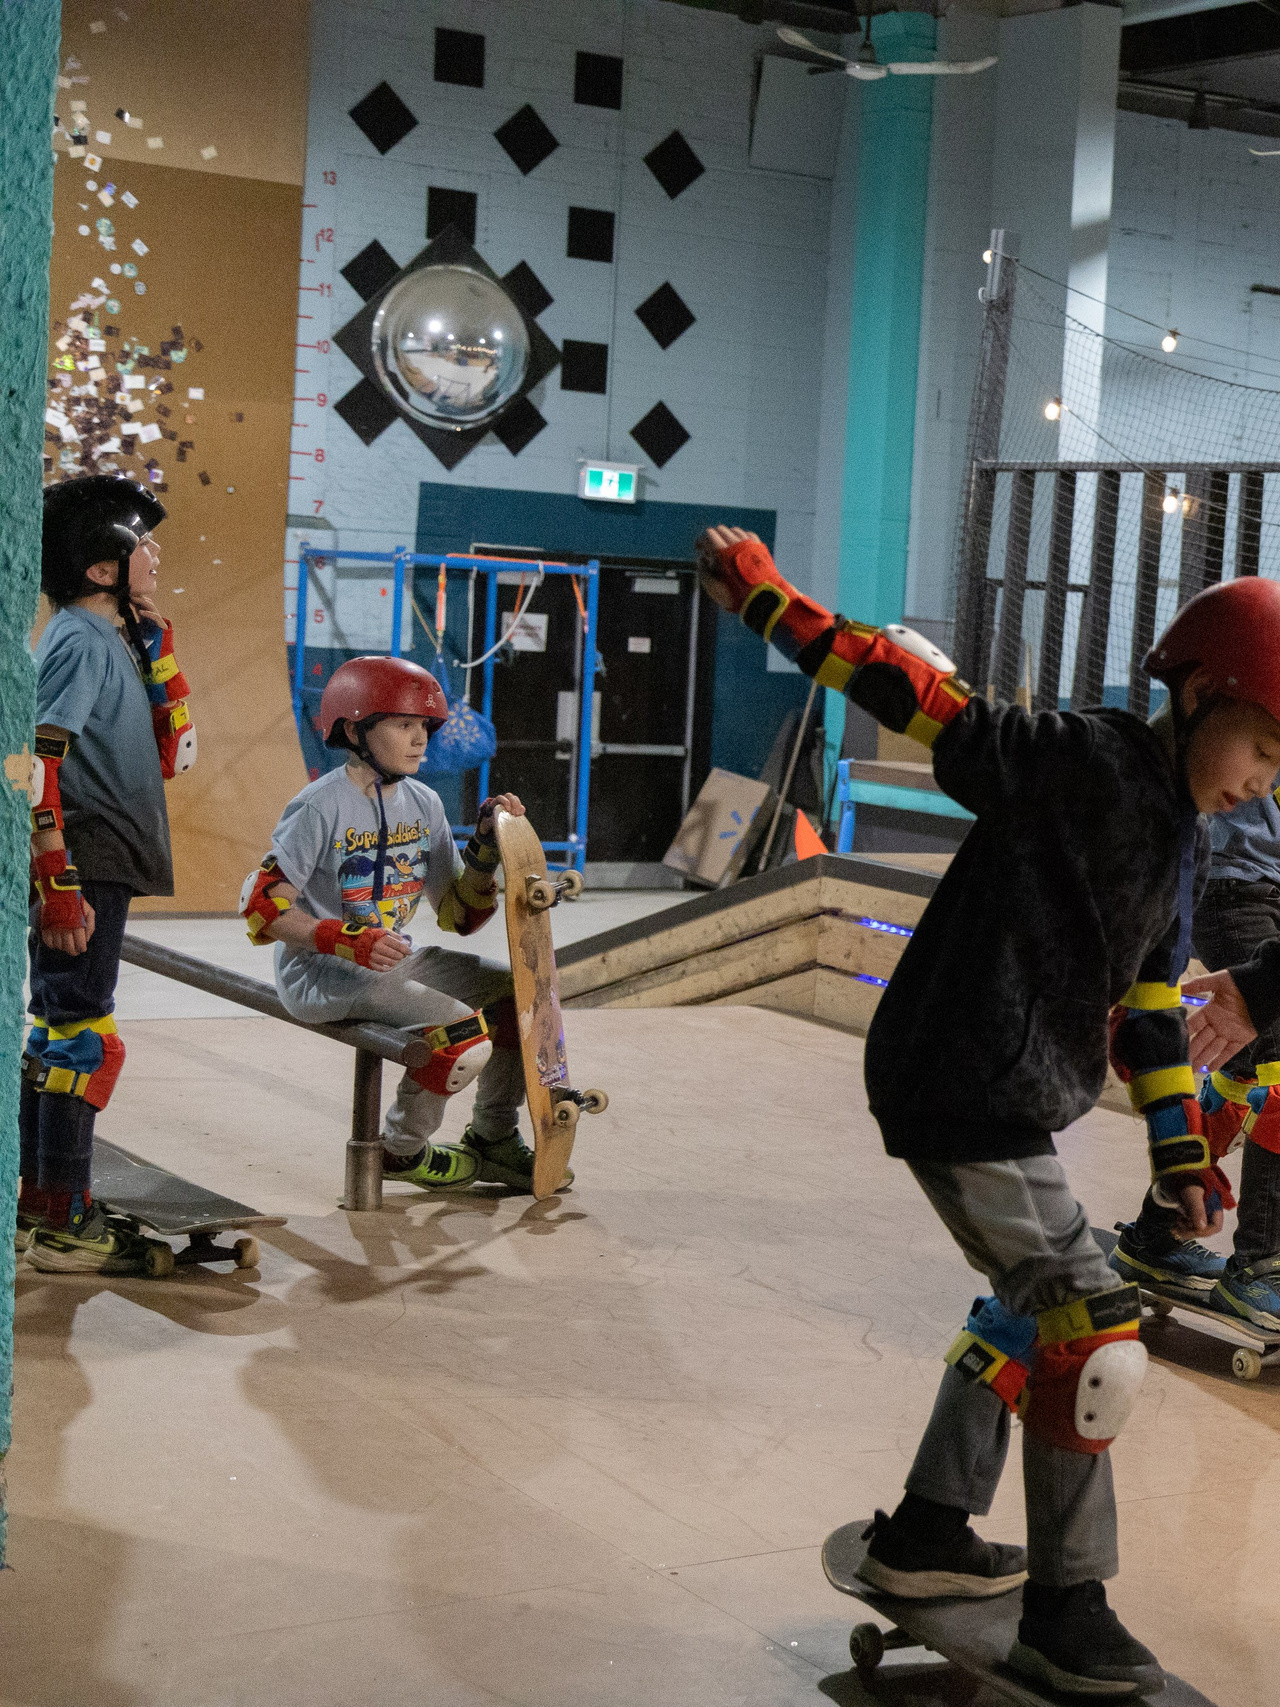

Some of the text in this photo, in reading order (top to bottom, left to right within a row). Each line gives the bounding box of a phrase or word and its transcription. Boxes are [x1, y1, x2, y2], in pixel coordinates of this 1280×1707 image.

[322, 170, 337, 185] 13
[319, 227, 334, 243] 12
[319, 283, 332, 298] 11
[317, 340, 330, 354] 10
[316, 393, 327, 407] 9
[314, 449, 325, 463] 8
[313, 500, 324, 514] 7
[314, 609, 325, 624] 5
[312, 663, 322, 676] 4
